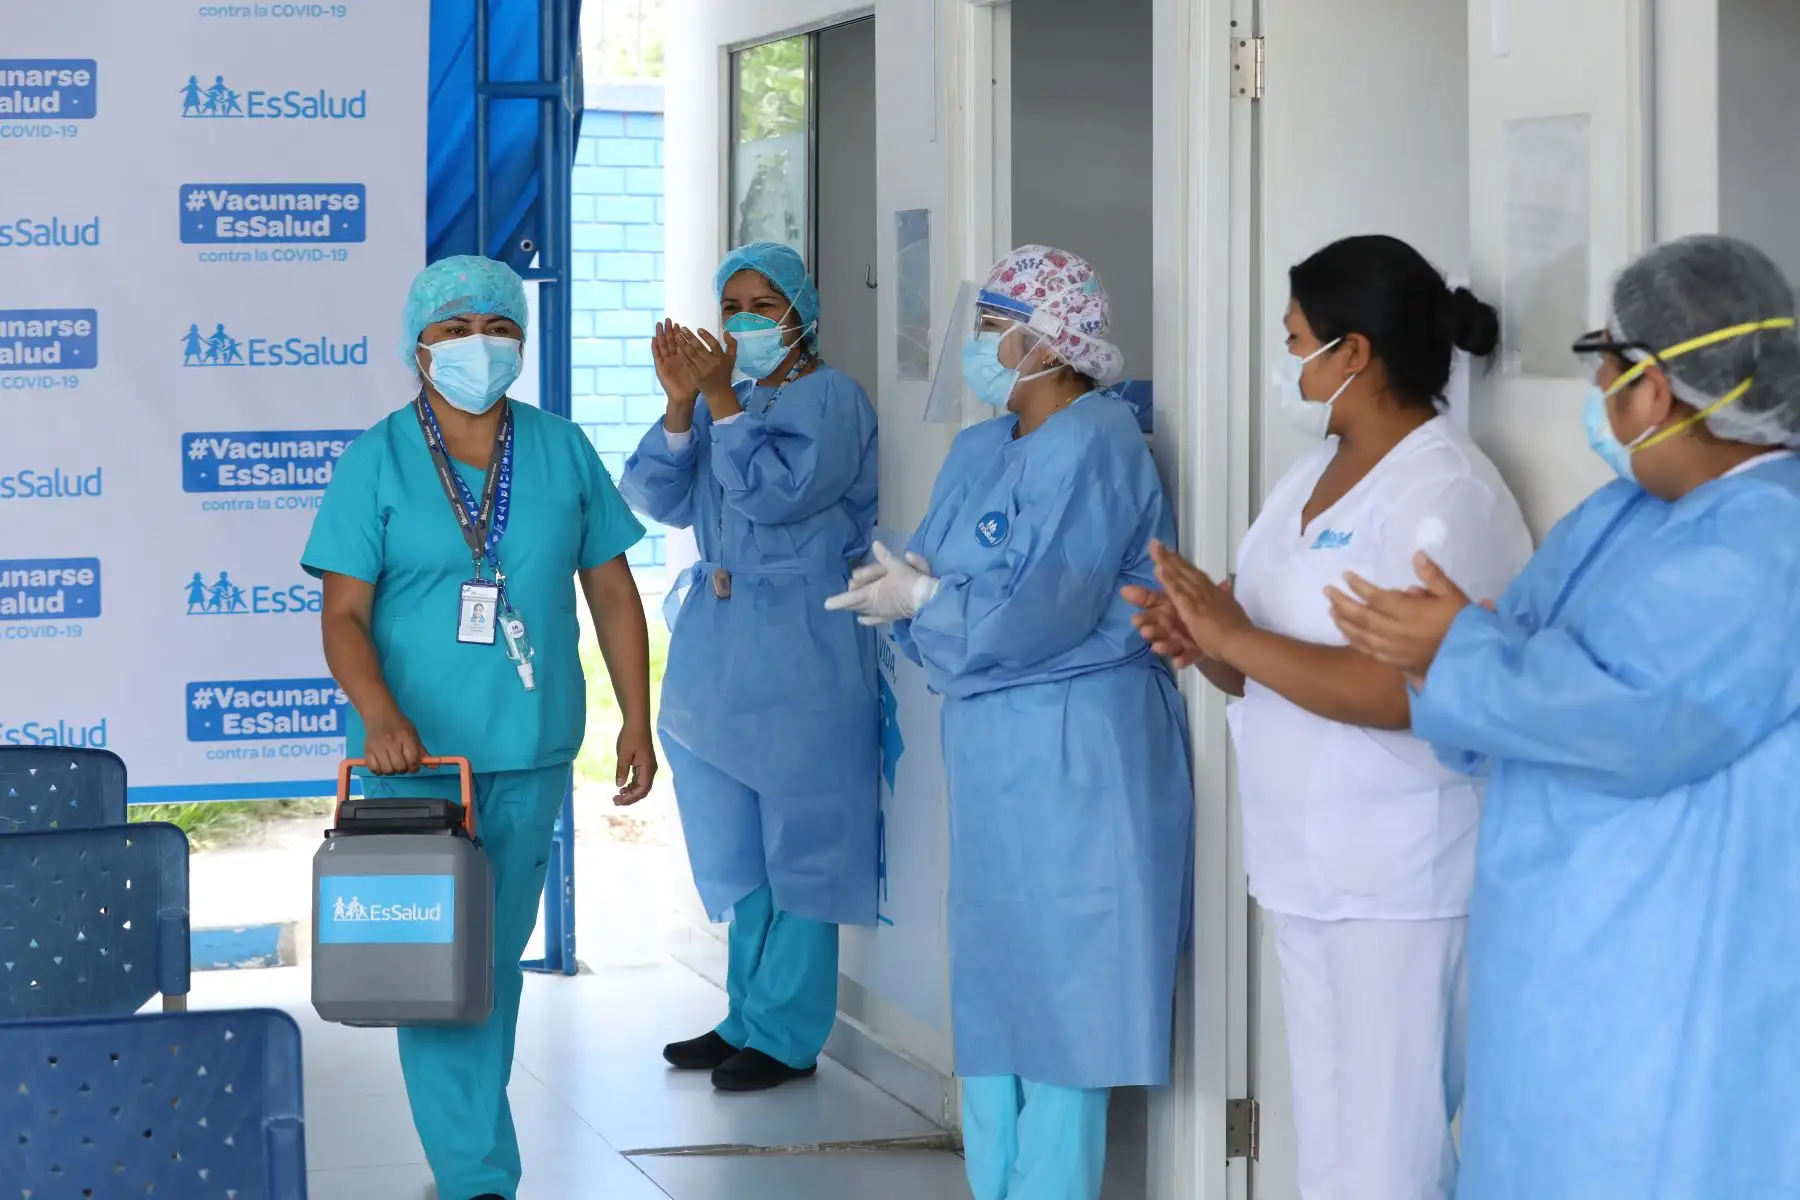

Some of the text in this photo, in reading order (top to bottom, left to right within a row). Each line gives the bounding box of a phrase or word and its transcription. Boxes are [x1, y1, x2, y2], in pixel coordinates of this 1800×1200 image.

[199, 3, 346, 17] contra la COVID-19
[0, 69, 90, 87] narse
[0, 90, 60, 113] alud
[247, 89, 366, 119] EsSalud
[0, 124, 77, 138] COVID-19
[186, 189, 360, 211] #Vacunarse
[0, 216, 99, 246] sSalud
[216, 214, 330, 237] EsSalud
[199, 248, 347, 262] contra la COVID-19
[0, 319, 91, 337] narse
[0, 340, 61, 364] alud
[249, 335, 368, 366] EsSalud
[2, 375, 78, 389] COVID-19
[188, 438, 354, 460] #Vacunars
[0, 466, 102, 498] sSalud
[218, 461, 333, 486] EsSalud
[202, 496, 324, 511] contra la COVID
[0, 568, 94, 588] unarse
[0, 589, 64, 615] alud
[252, 585, 323, 613] EsSa
[5, 624, 82, 639] COVID-19
[192, 687, 349, 710] #Vacunars
[0, 717, 106, 748] sSalud
[222, 709, 337, 735] EsSalud
[206, 744, 344, 761] contra la COVID-1
[370, 903, 441, 922] EsSalud
